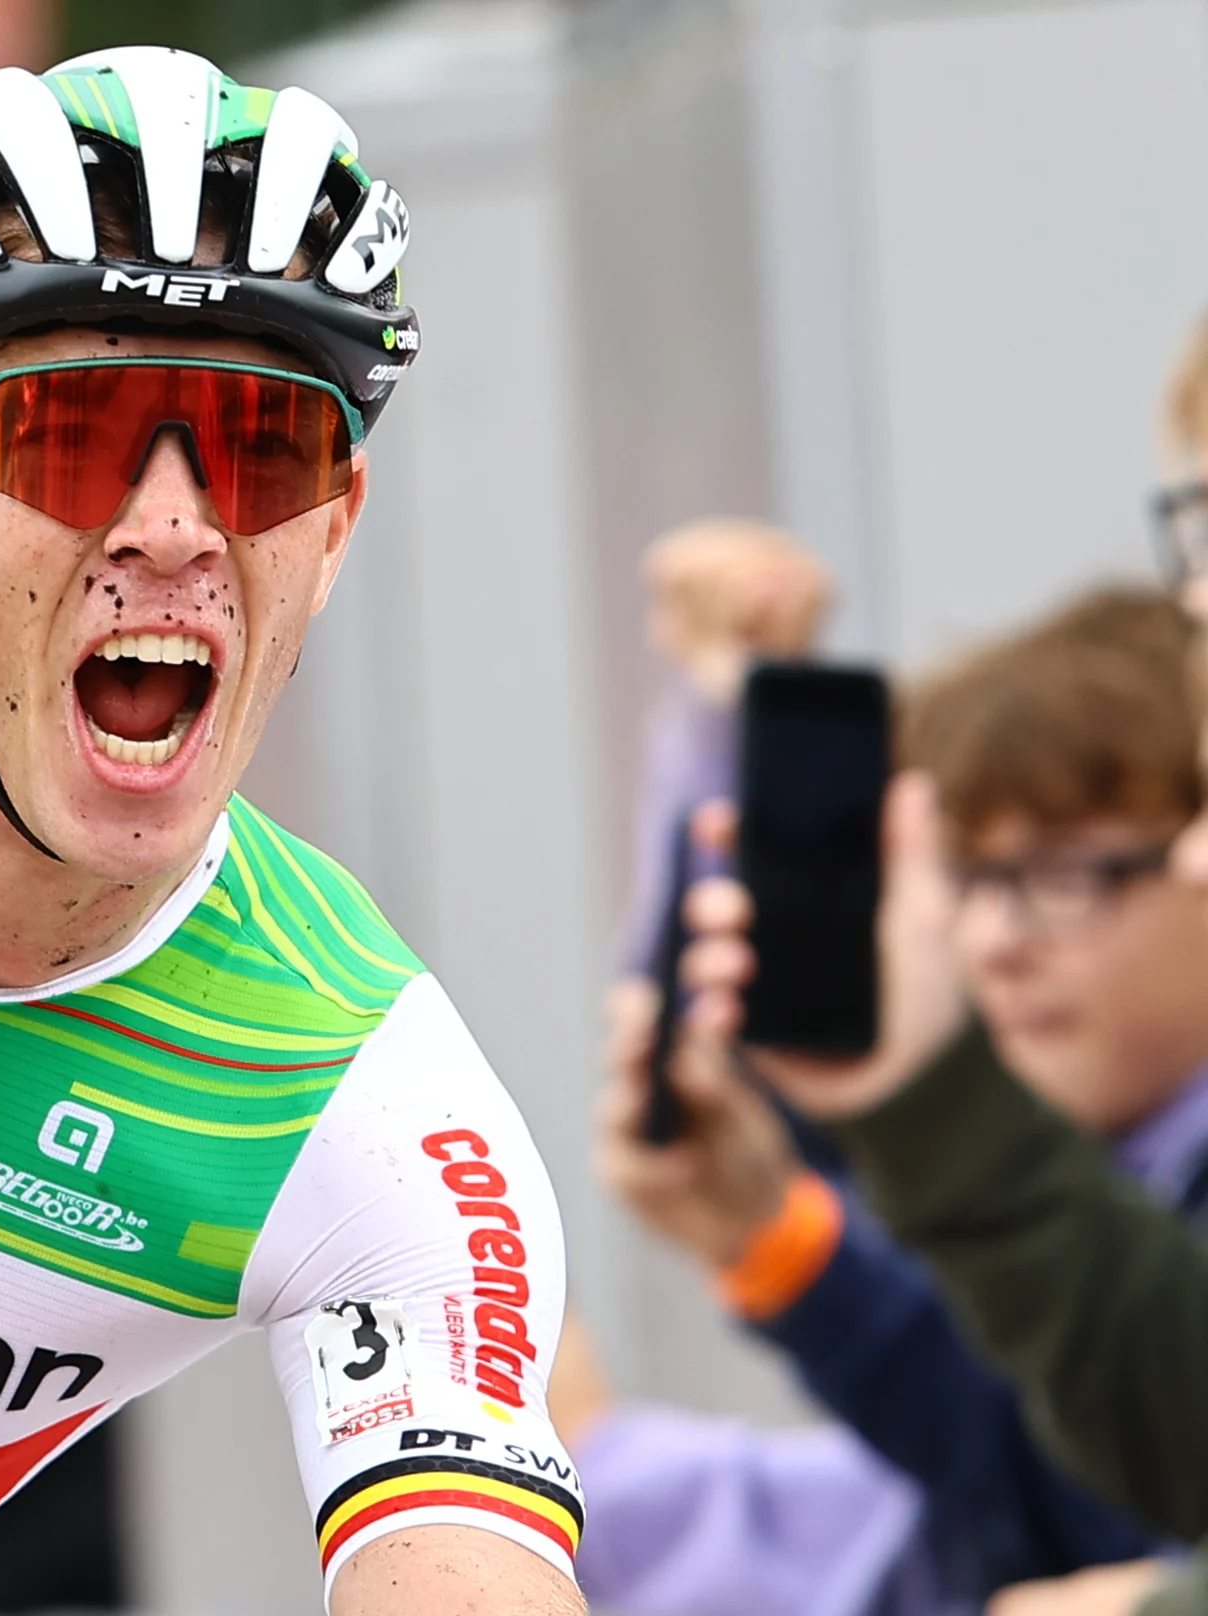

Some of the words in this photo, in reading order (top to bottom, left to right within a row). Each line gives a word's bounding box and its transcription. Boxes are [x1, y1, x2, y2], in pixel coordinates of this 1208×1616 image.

[101, 269, 240, 308] MET
[395, 324, 419, 351] crela
[55, 1191, 93, 1212] IVECO
[334, 1300, 390, 1381] 3
[399, 1429, 487, 1452] DT
